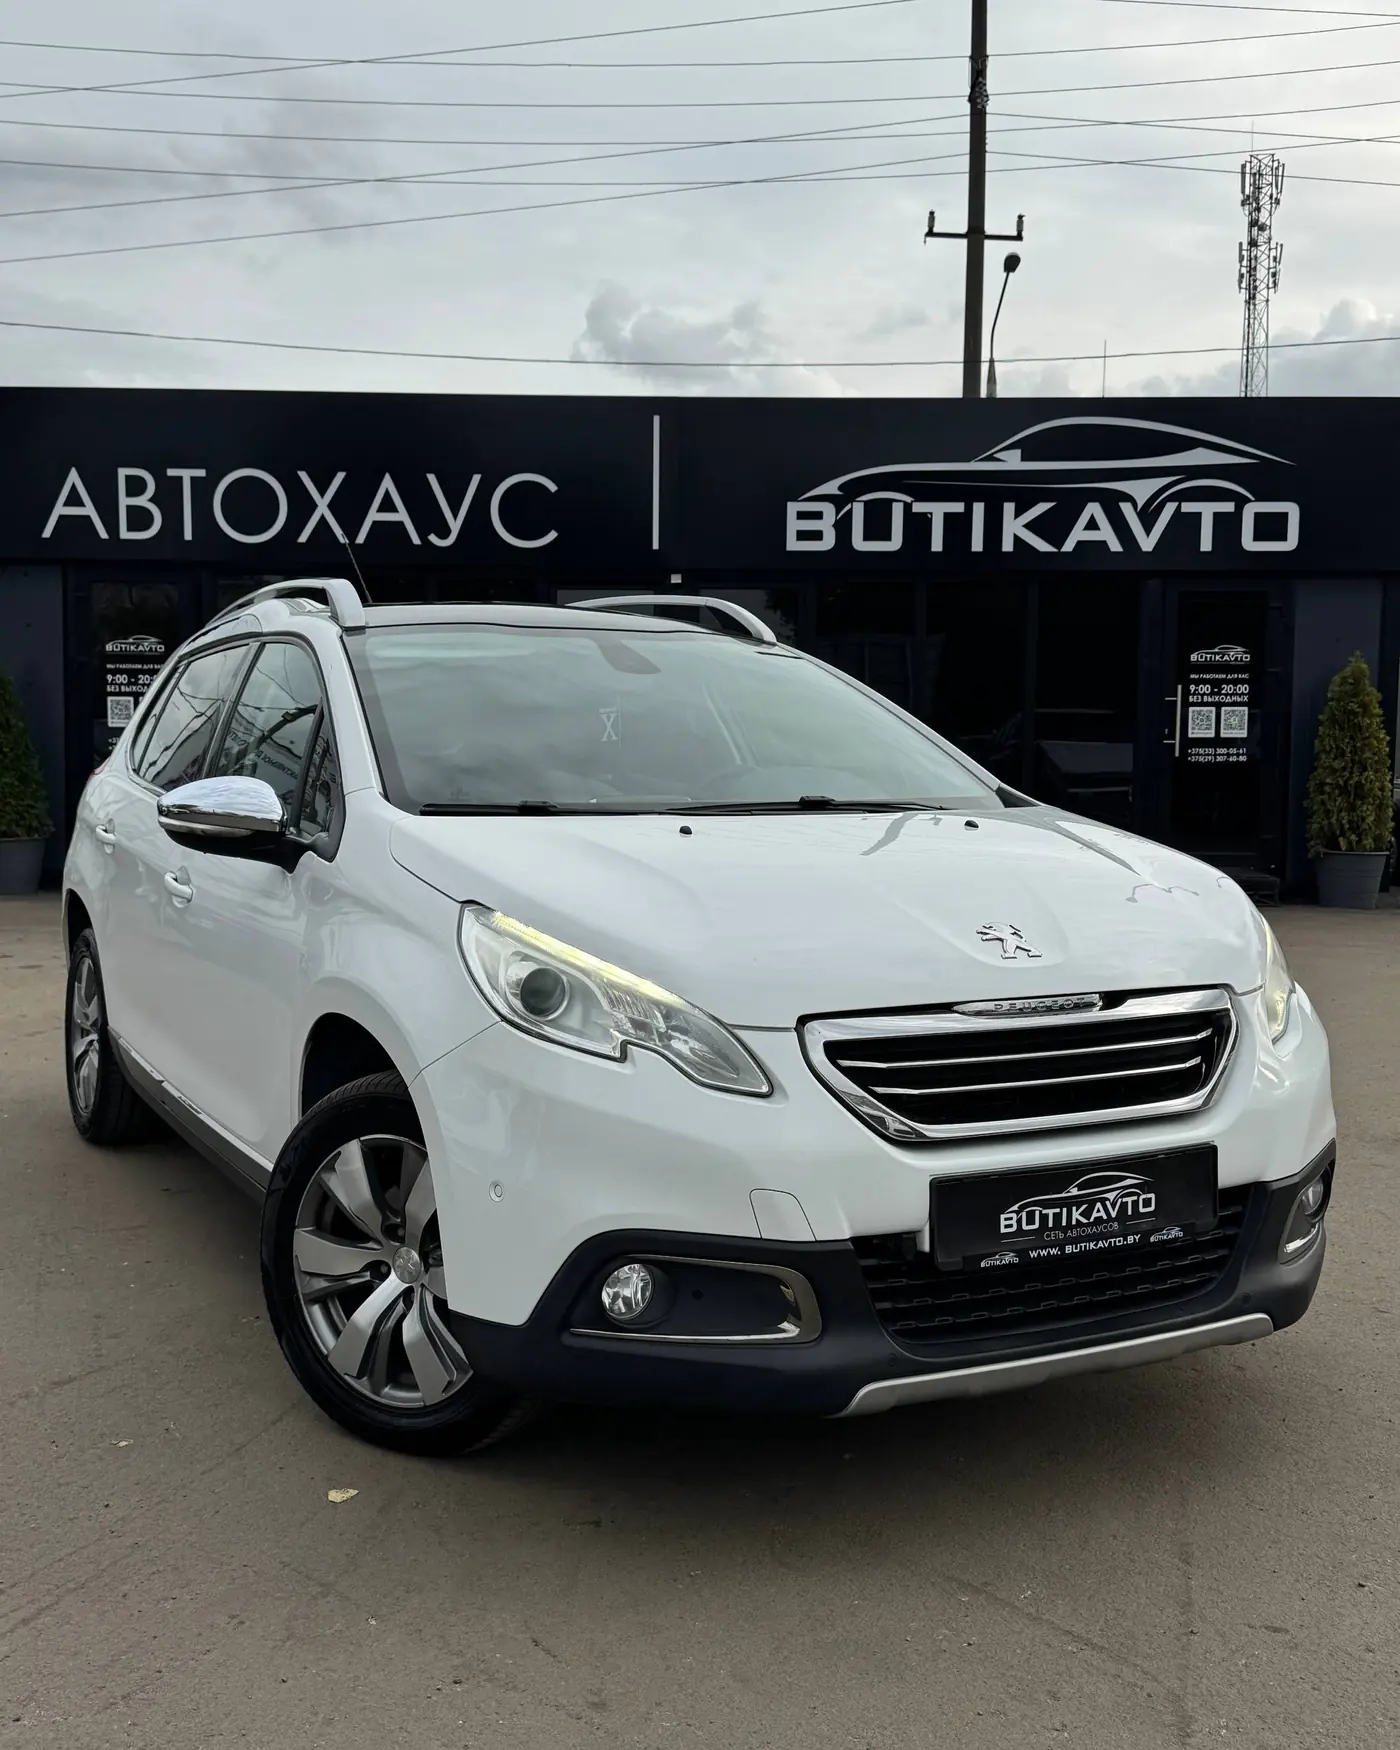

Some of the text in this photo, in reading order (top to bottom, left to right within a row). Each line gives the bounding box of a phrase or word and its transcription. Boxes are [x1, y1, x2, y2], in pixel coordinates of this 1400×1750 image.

[41, 466, 559, 549] АВТОХАУС
[786, 501, 1300, 552] BUTIKAVTO
[105, 644, 165, 652] BUTIKAVTO
[106, 674, 128, 684] 9:00
[1189, 684, 1211, 694] 9:00
[1220, 684, 1250, 694] 20:00
[1203, 695, 1249, 703] ВЫХОДНЫХ
[993, 997, 1086, 1012] PEUGEOT
[1000, 1193, 1156, 1233] BUTIKAVTO
[1044, 1221, 1119, 1241] СЕТЬ АВТОХАУСОВ
[1150, 1231, 1184, 1243] BUTIKAVTO
[1029, 1234, 1141, 1259] WWW. BUTIKAVTO.BY
[980, 1256, 1019, 1268] BUTIKAVTO
